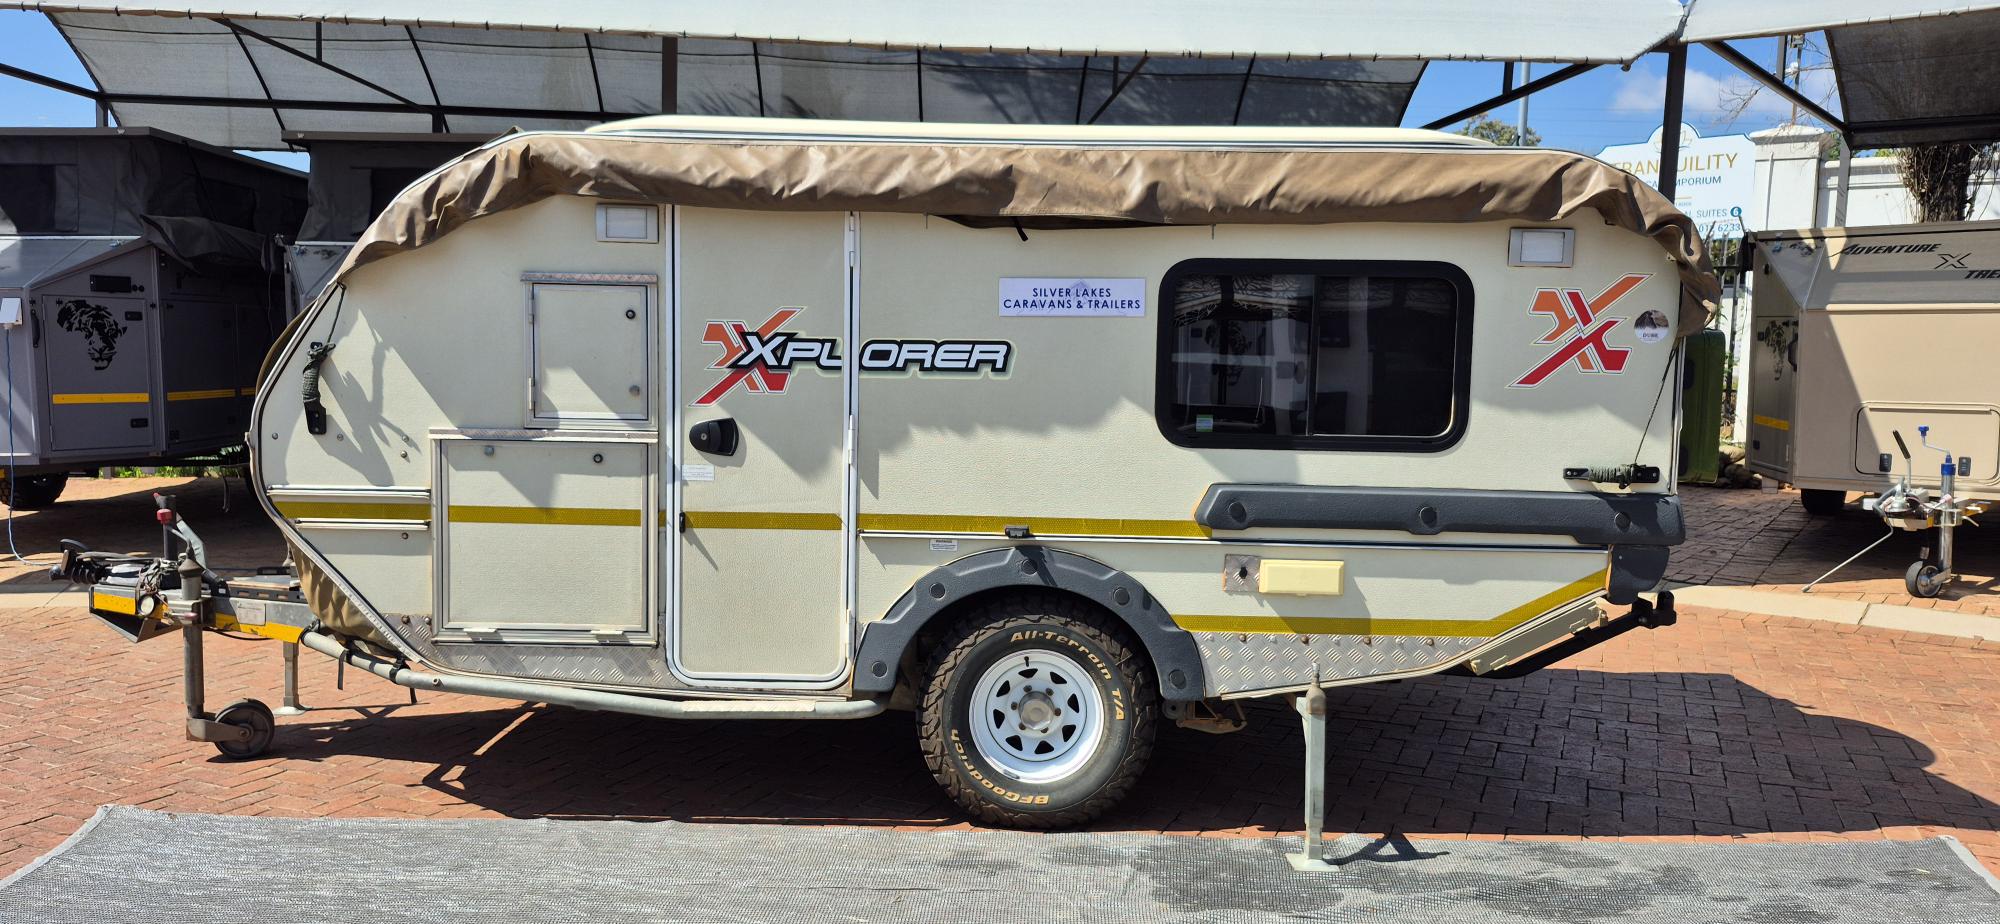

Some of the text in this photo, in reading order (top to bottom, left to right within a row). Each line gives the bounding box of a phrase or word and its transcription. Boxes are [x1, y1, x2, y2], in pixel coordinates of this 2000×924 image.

[1612, 152, 1738, 175] RANUILITY
[1675, 176, 1721, 187] MPORIUM
[1696, 208, 1727, 218] SUITES
[1836, 243, 1941, 256] ADVENTURE
[1964, 269, 2000, 279] TRE
[1032, 287, 1111, 298] SILVER LAKES
[1003, 299, 1141, 309] CARAVANS & TRAILERS
[730, 332, 1011, 371] XPLORER
[1010, 631, 1125, 720] All-Terrain T/A
[950, 728, 1049, 805] BFGoodrich
